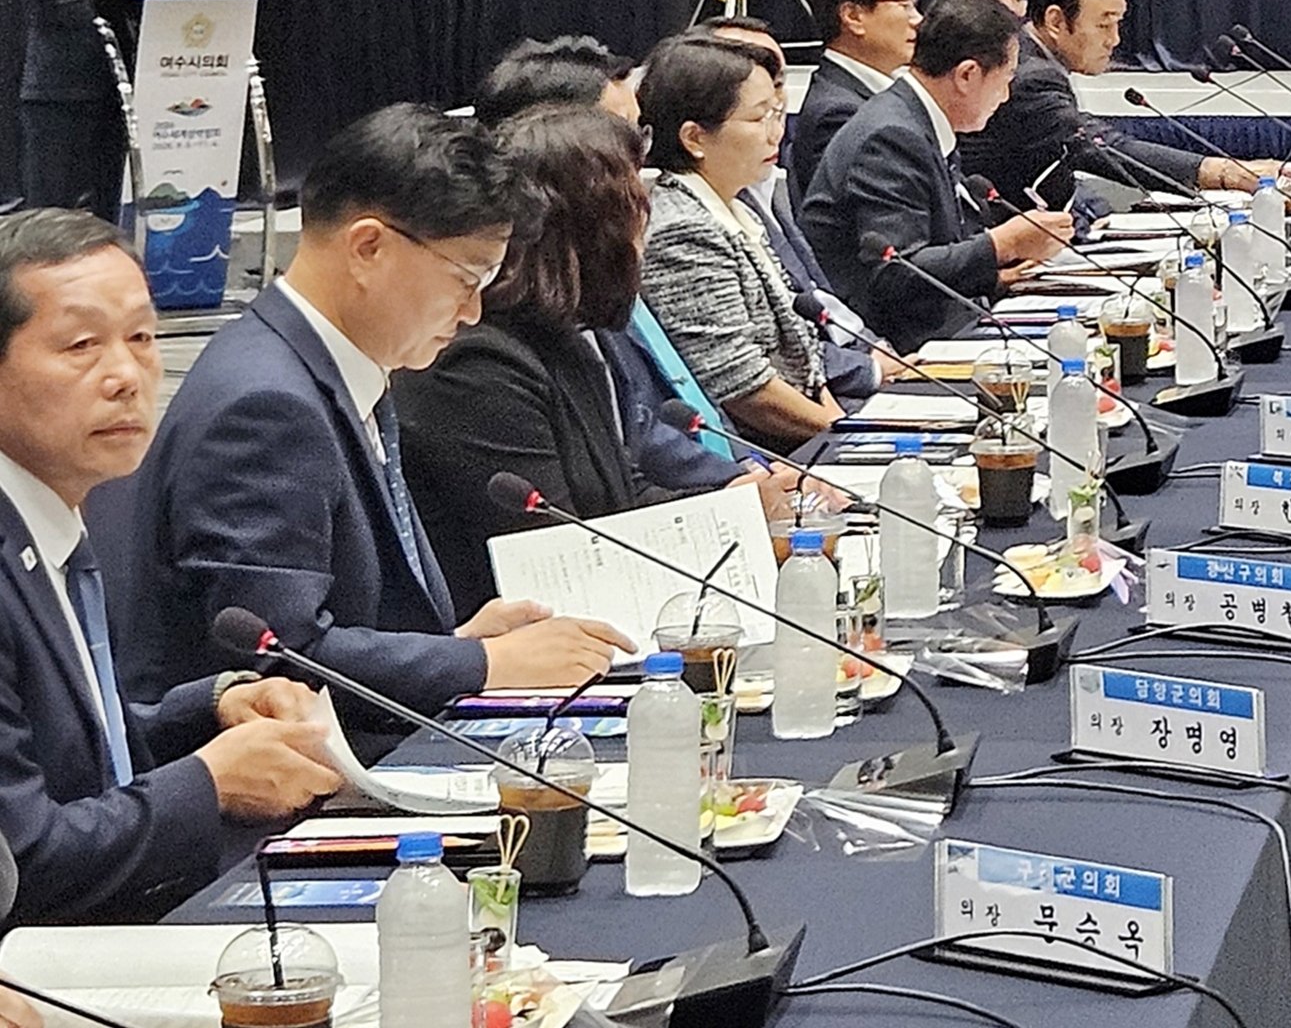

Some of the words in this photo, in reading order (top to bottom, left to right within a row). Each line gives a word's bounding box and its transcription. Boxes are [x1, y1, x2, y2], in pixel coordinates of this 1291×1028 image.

[160, 54, 229, 70] 여수시의회
[1205, 560, 1285, 587] 광산구의회
[1164, 591, 1196, 612] 의장
[1134, 677, 1222, 711] 담양군의회
[1090, 712, 1124, 737] 의장
[1149, 715, 1239, 761] 장명영
[960, 898, 1002, 928] 의장
